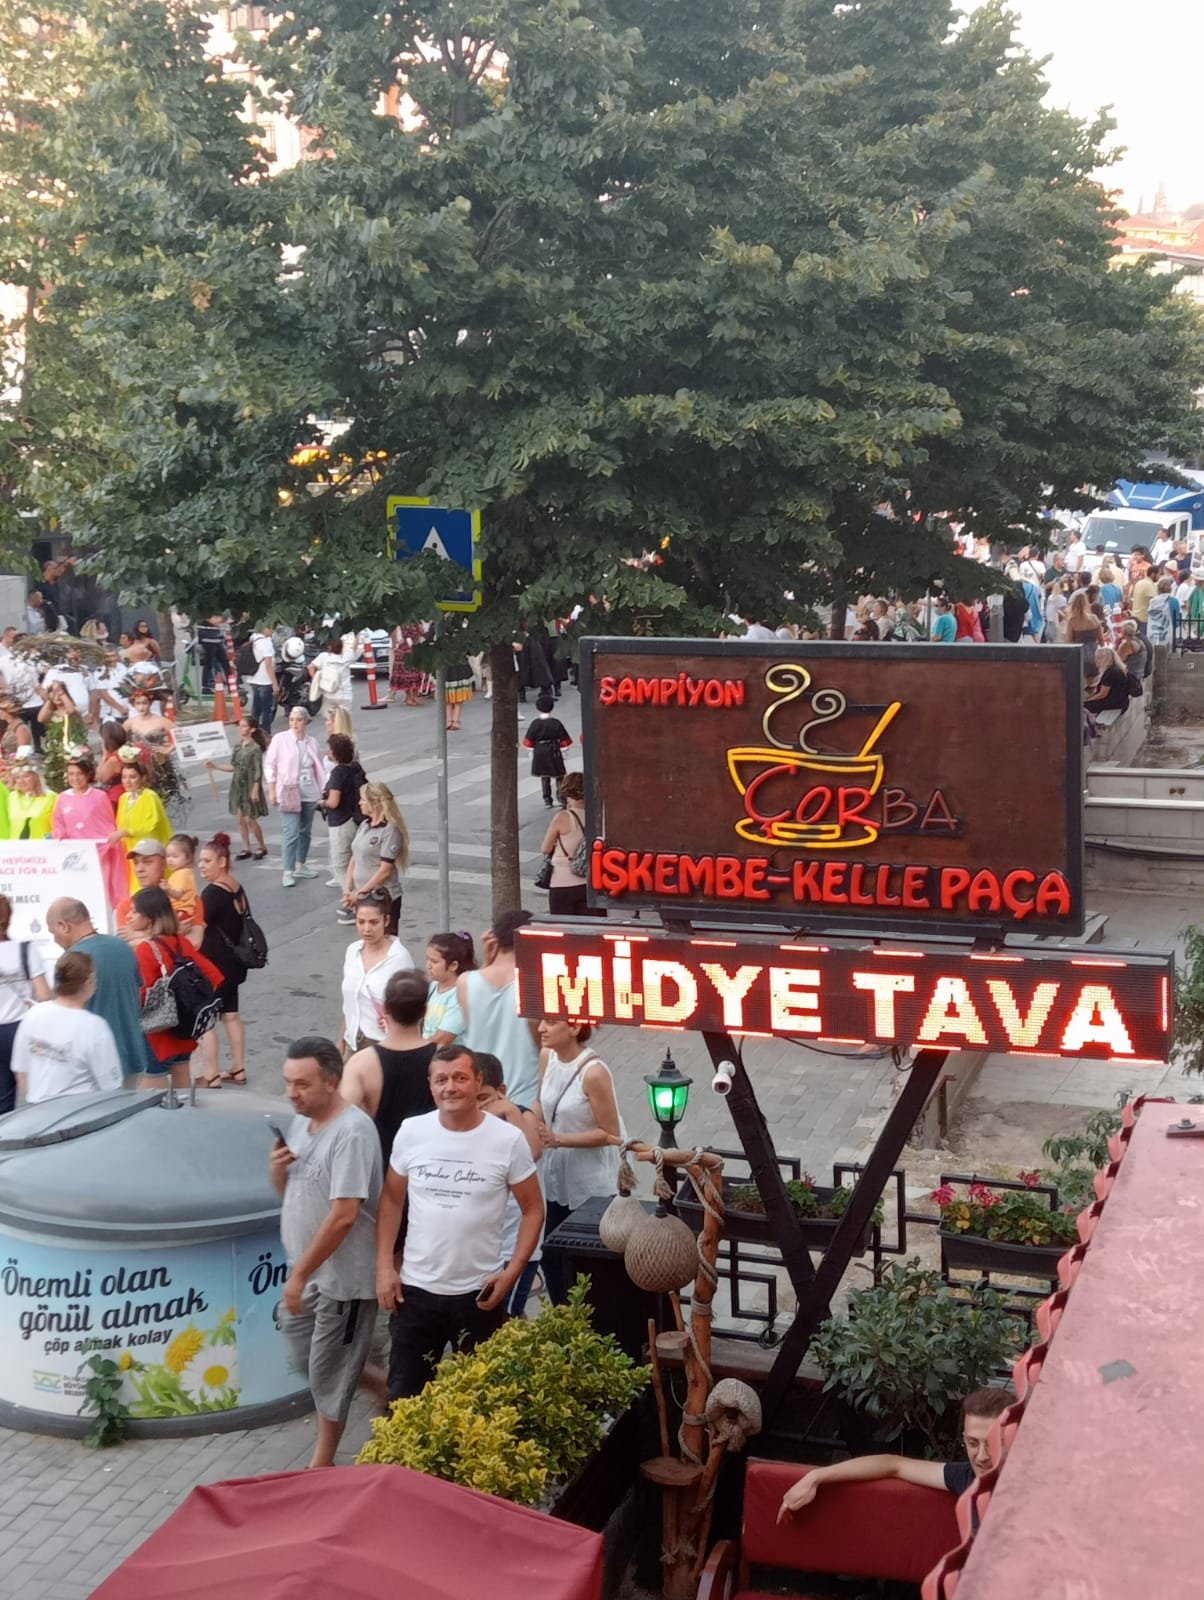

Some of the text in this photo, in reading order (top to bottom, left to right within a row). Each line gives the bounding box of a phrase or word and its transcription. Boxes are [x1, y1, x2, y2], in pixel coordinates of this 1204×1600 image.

[743, 765, 960, 841] ÇORBA
[18, 866, 37, 875] FOR
[41, 866, 57, 875] ALL
[941, 867, 1071, 920] PAÇA
[541, 940, 1135, 1055] MİDYE TAVA
[1, 1258, 172, 1299] Önemli olan
[19, 1287, 209, 1341] gönül almak
[44, 1337, 69, 1355] çöp
[127, 1328, 173, 1349] kolay
